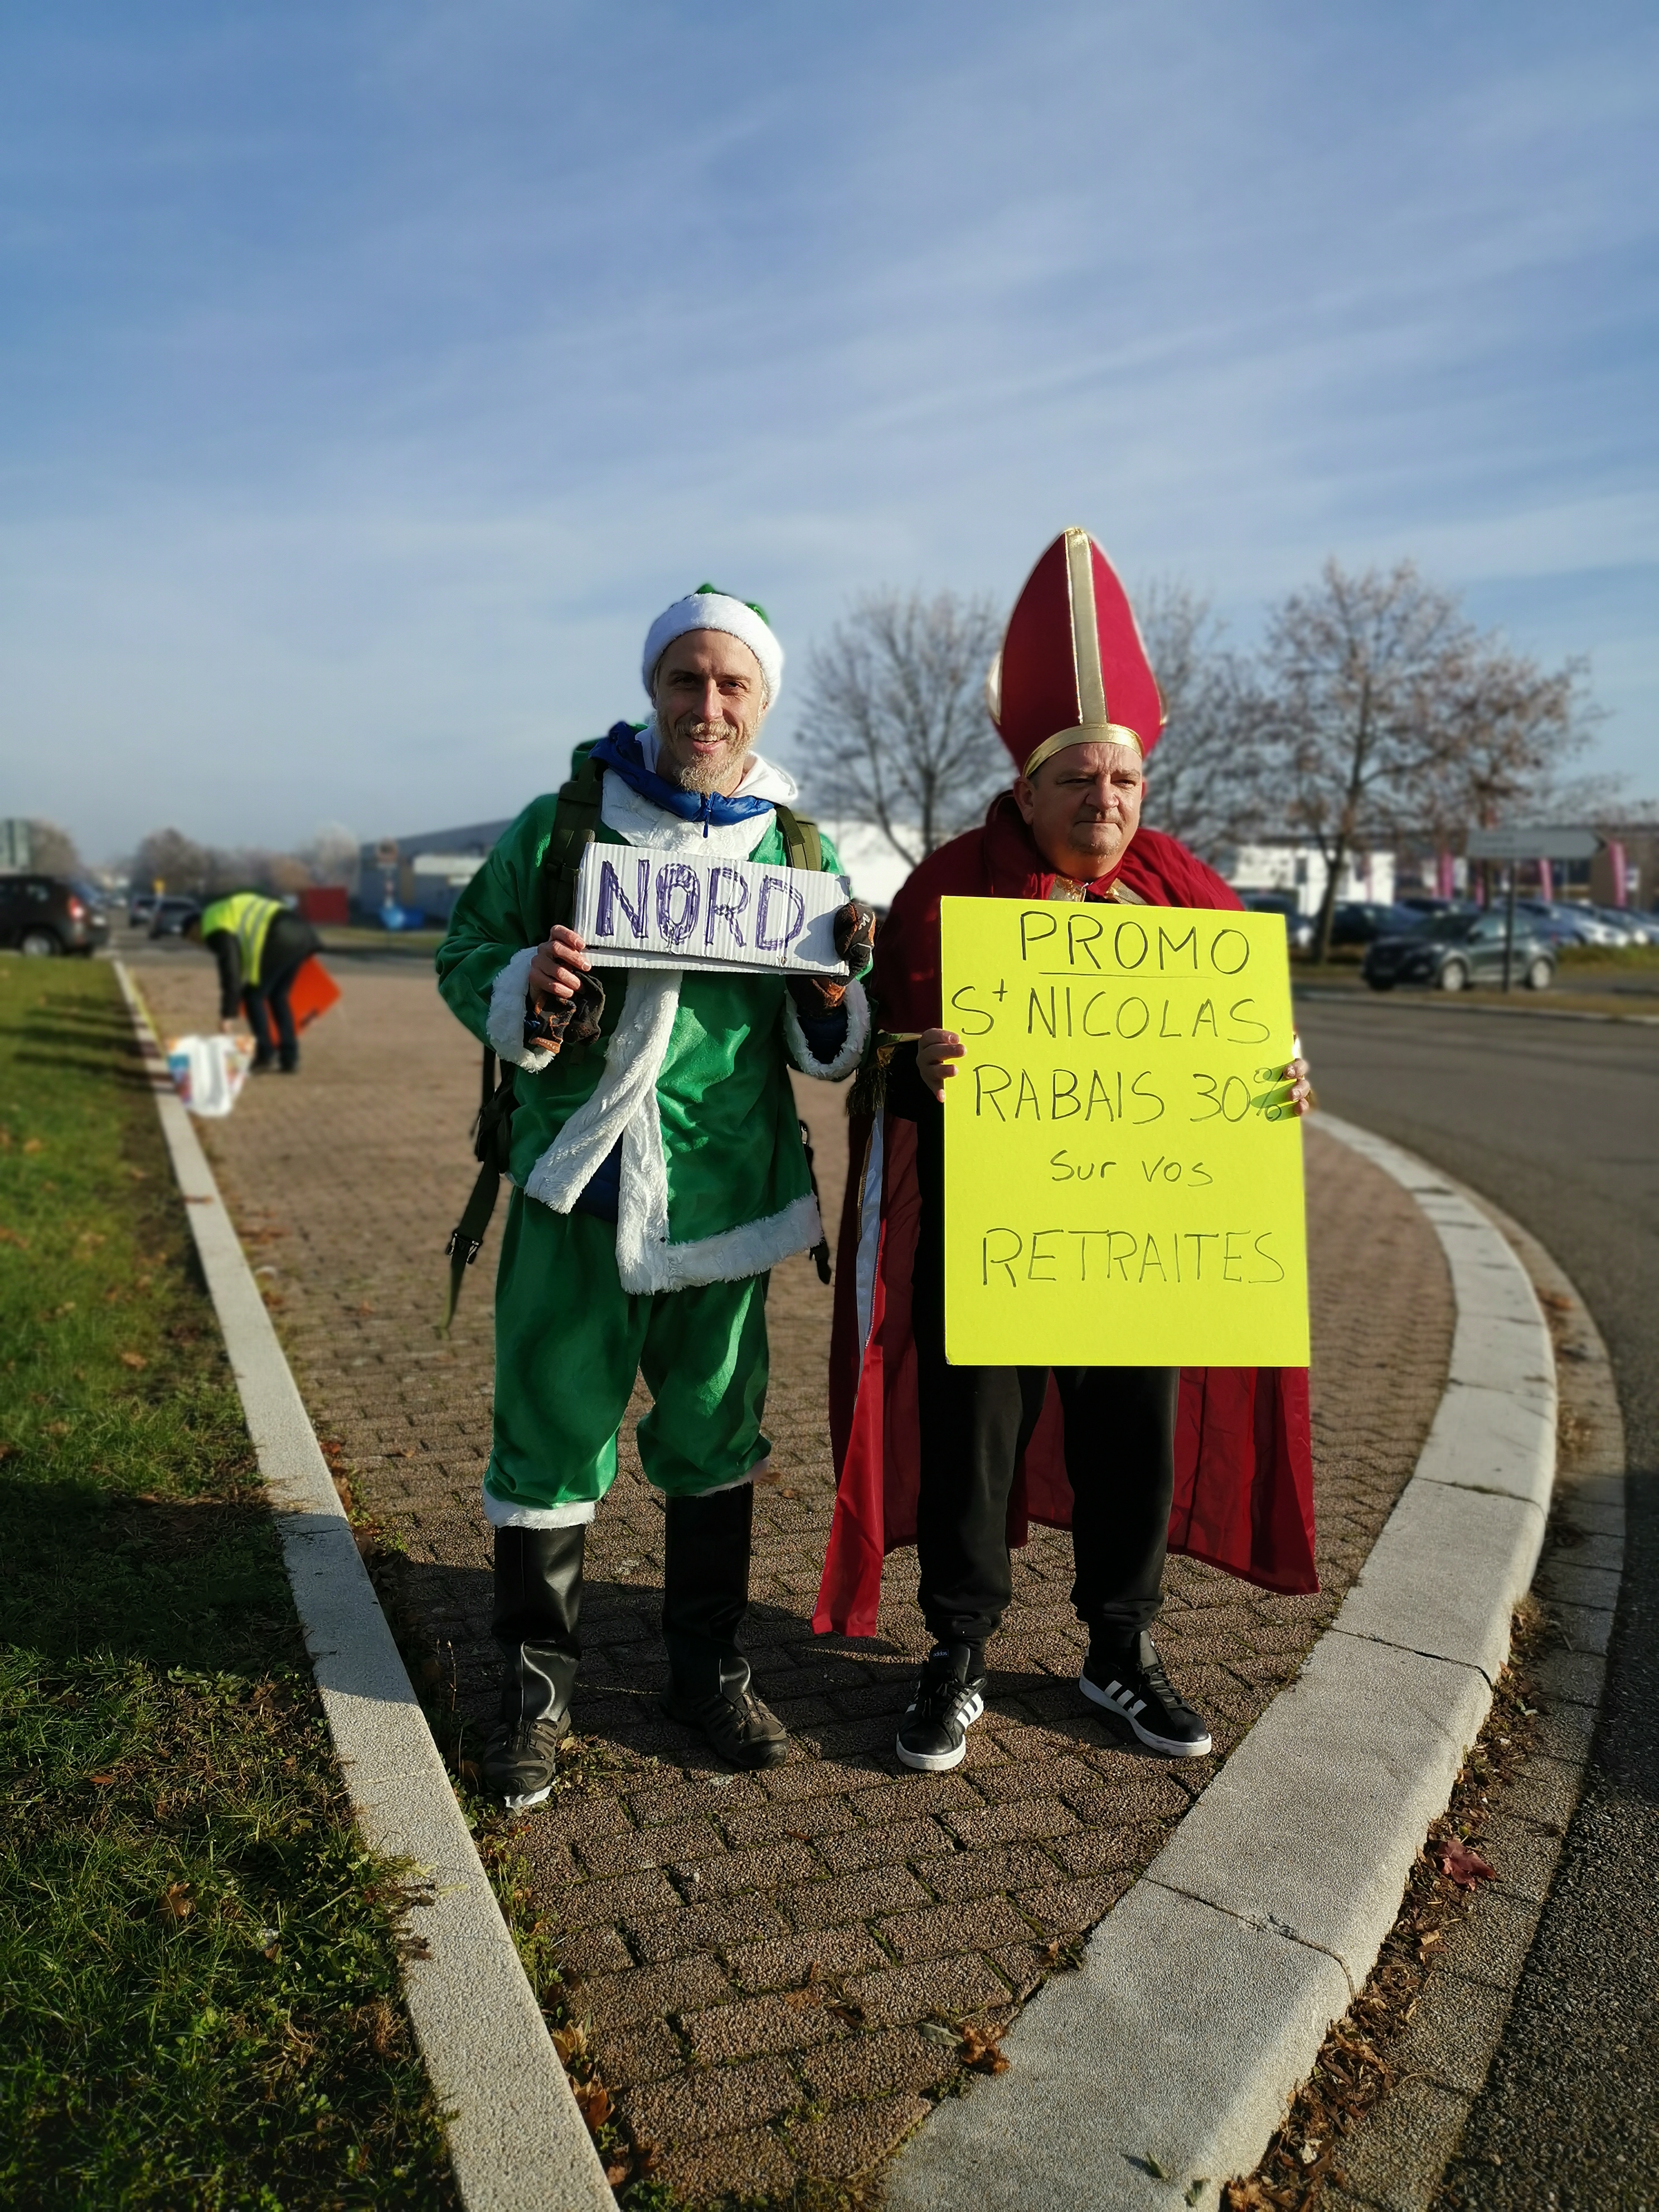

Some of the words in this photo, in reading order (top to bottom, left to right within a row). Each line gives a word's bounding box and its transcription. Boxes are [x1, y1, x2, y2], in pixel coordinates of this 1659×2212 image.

[595, 858, 805, 951] NORD
[1020, 910, 1250, 975] PROMO
[1027, 986, 1270, 1044] NICOLAS
[972, 1064, 1166, 1125] RABAIS
[1189, 1067, 1284, 1123] 30%
[982, 1228, 1285, 1288] RETRAITES
